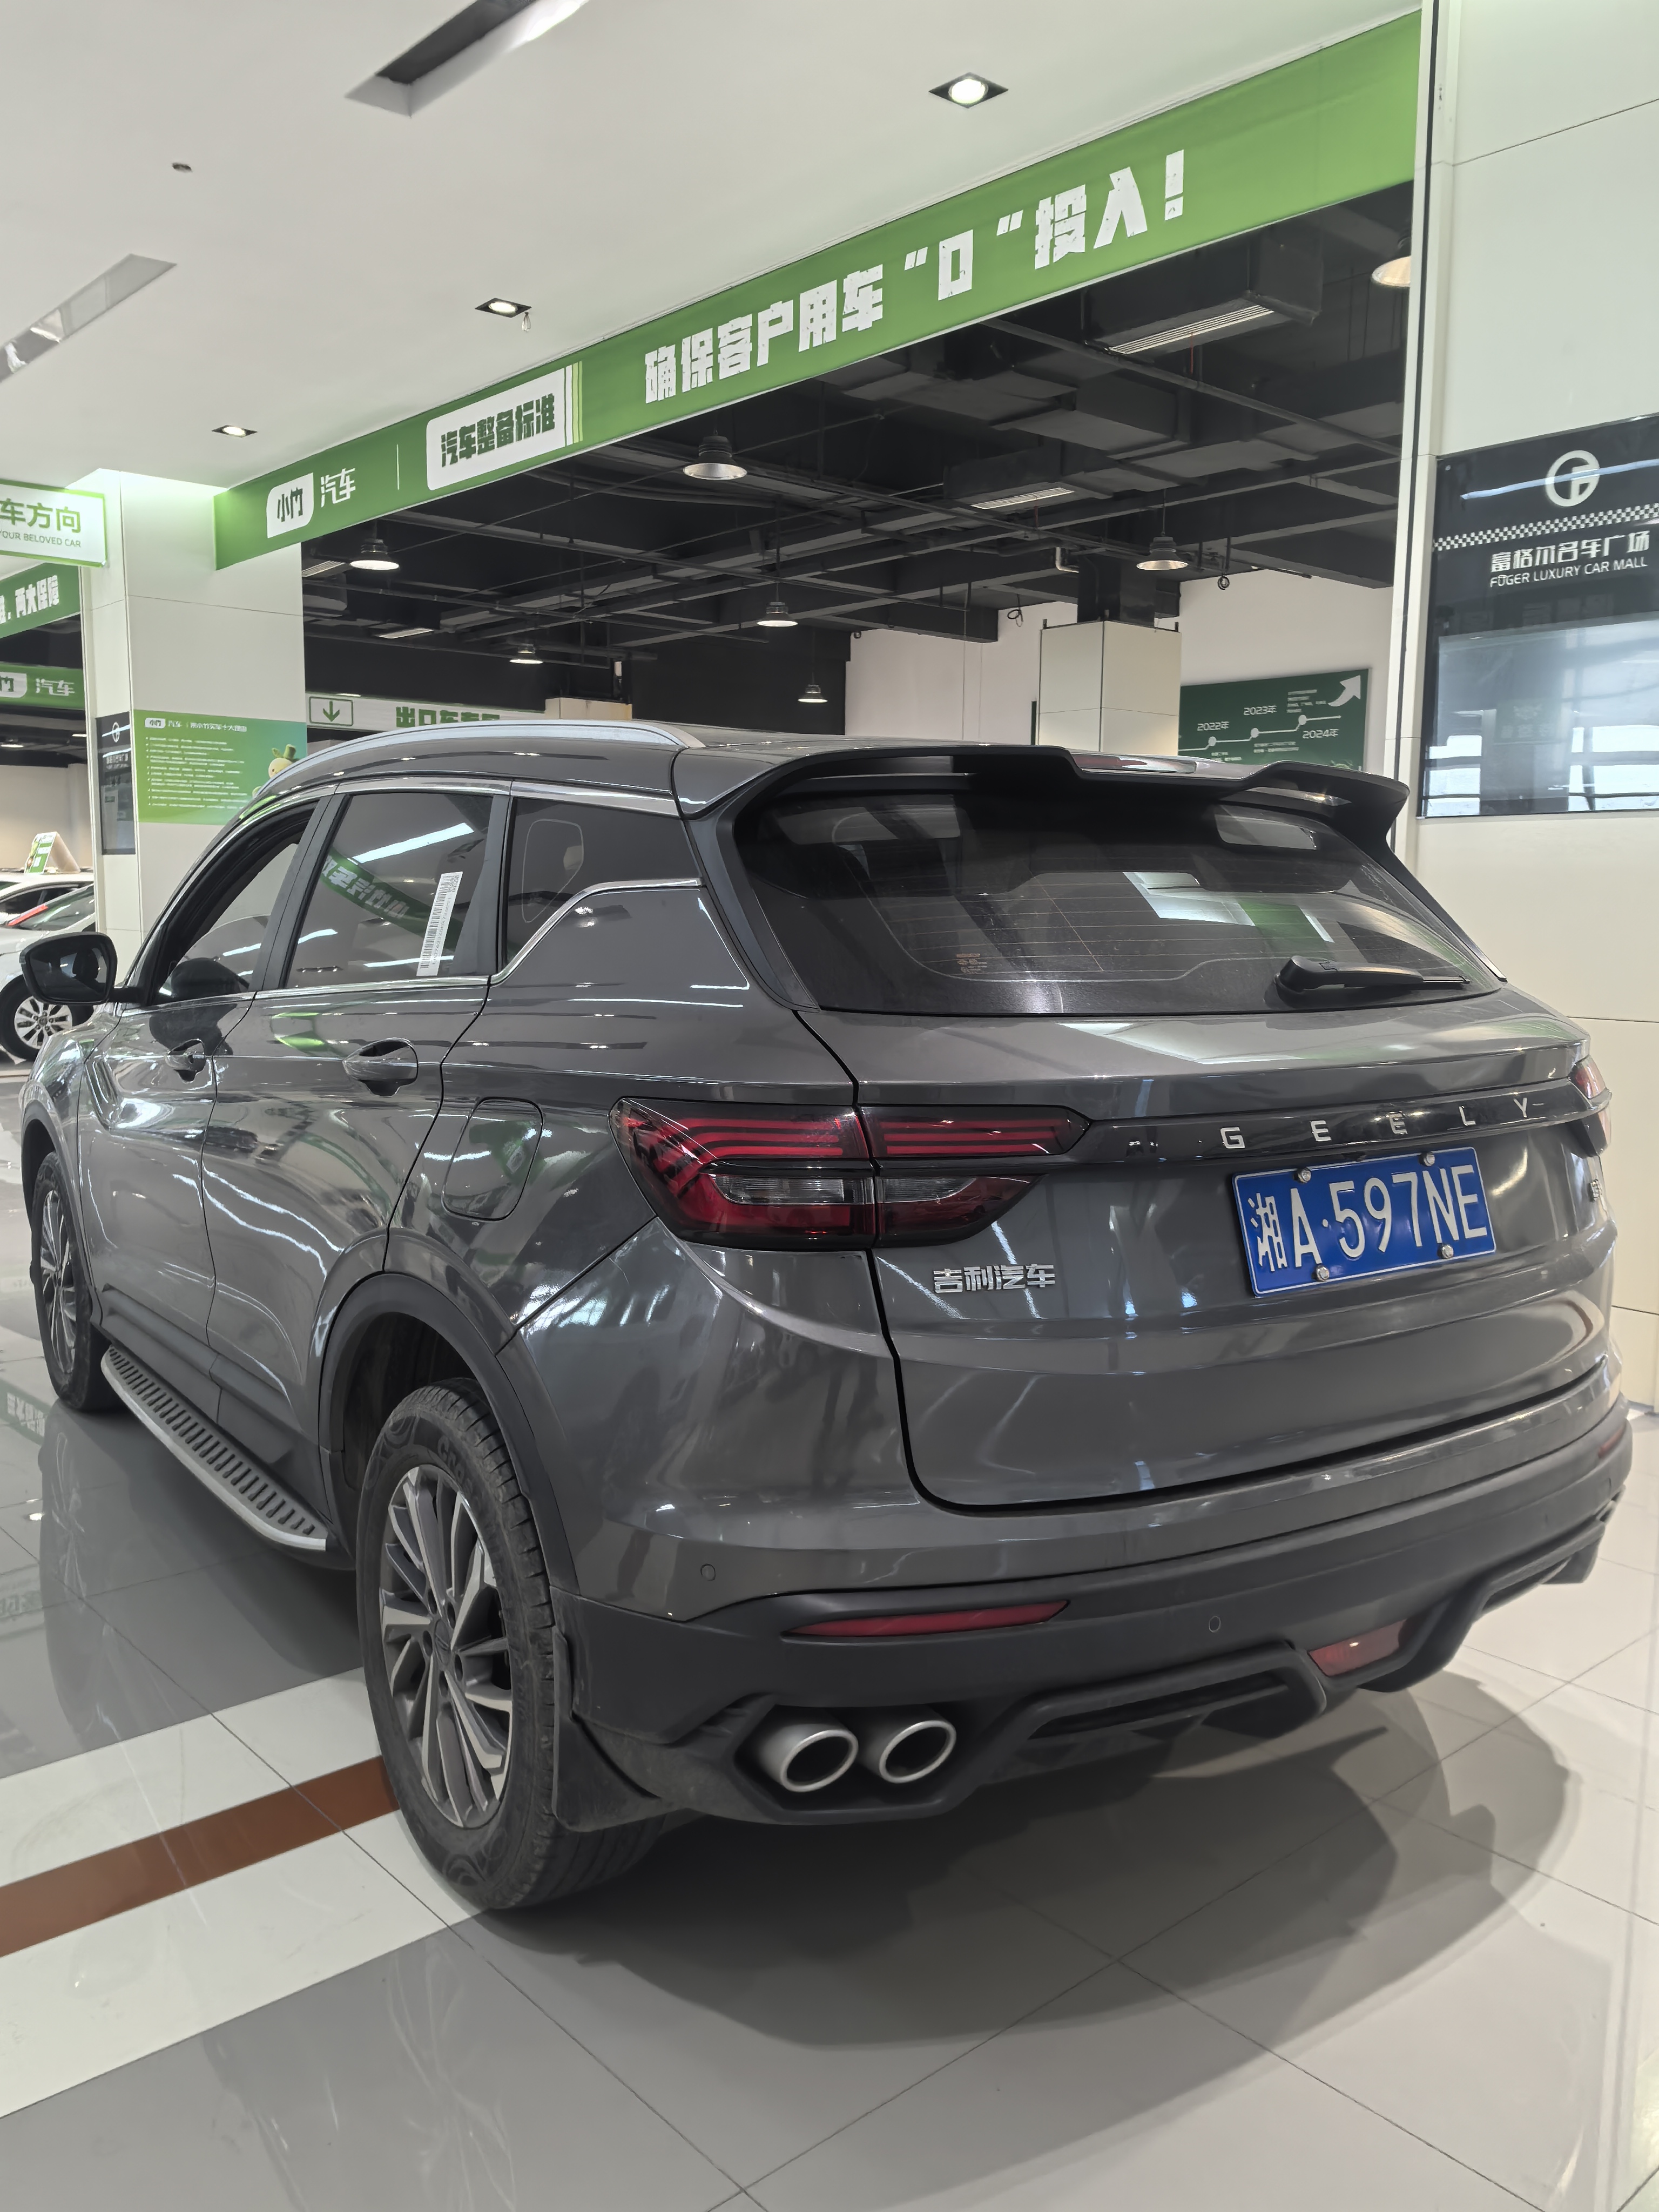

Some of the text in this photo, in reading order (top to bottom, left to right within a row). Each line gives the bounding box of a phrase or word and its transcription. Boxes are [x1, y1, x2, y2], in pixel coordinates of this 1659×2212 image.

[441, 393, 555, 468] 汽车整备标准
[277, 468, 356, 522] 小竹 汽车
[0, 498, 81, 533] 车方向
[24, 534, 63, 545] BELOVED
[65, 539, 81, 548] CAR
[1491, 530, 1650, 572] 富格尔名车广场
[1534, 565, 1581, 582] LUXURY
[1584, 561, 1610, 575] CAR
[1613, 556, 1648, 571] MALL
[36, 678, 76, 697] 汽车
[1243, 705, 1277, 716] 2023年
[1197, 721, 1230, 731] 2022年
[1302, 729, 1339, 739] 2024年
[1220, 1097, 1528, 1149] GEELY
[933, 1264, 1056, 1293] 吉利汽车
